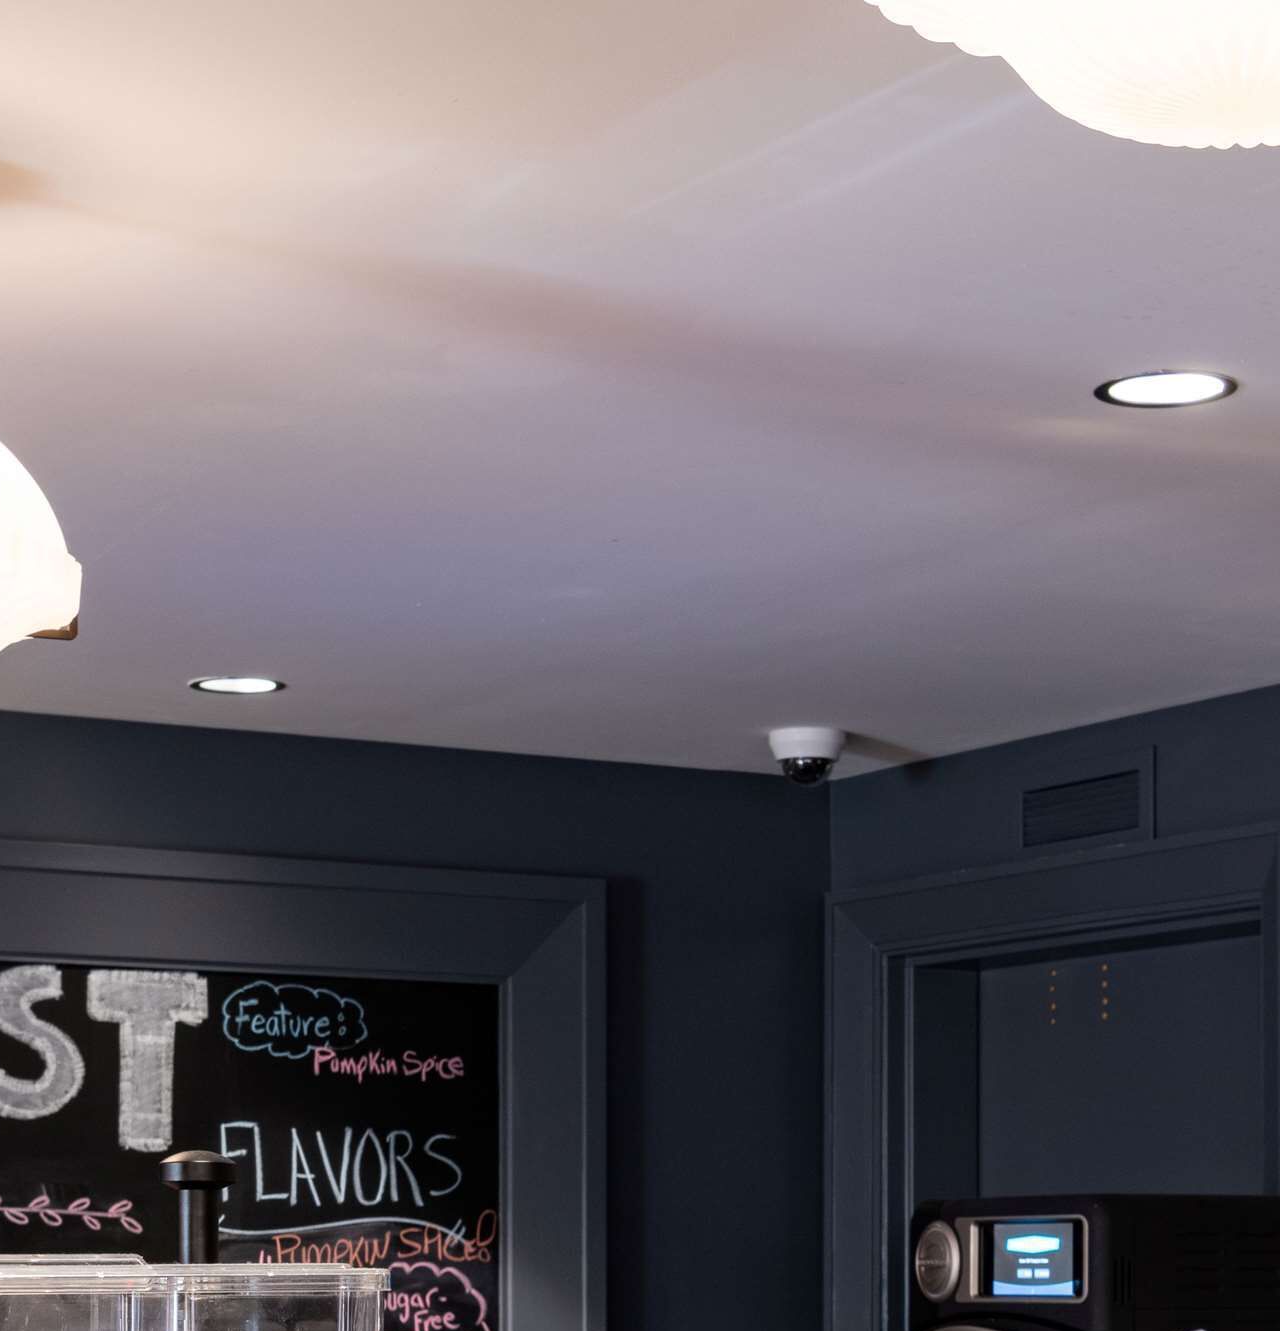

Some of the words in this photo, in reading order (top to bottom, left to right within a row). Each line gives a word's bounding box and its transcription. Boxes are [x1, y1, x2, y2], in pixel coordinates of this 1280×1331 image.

[403, 1050, 464, 1081] Spice
[220, 1121, 462, 1206] FLAVORS
[384, 1288, 448, 1324] ugar-
